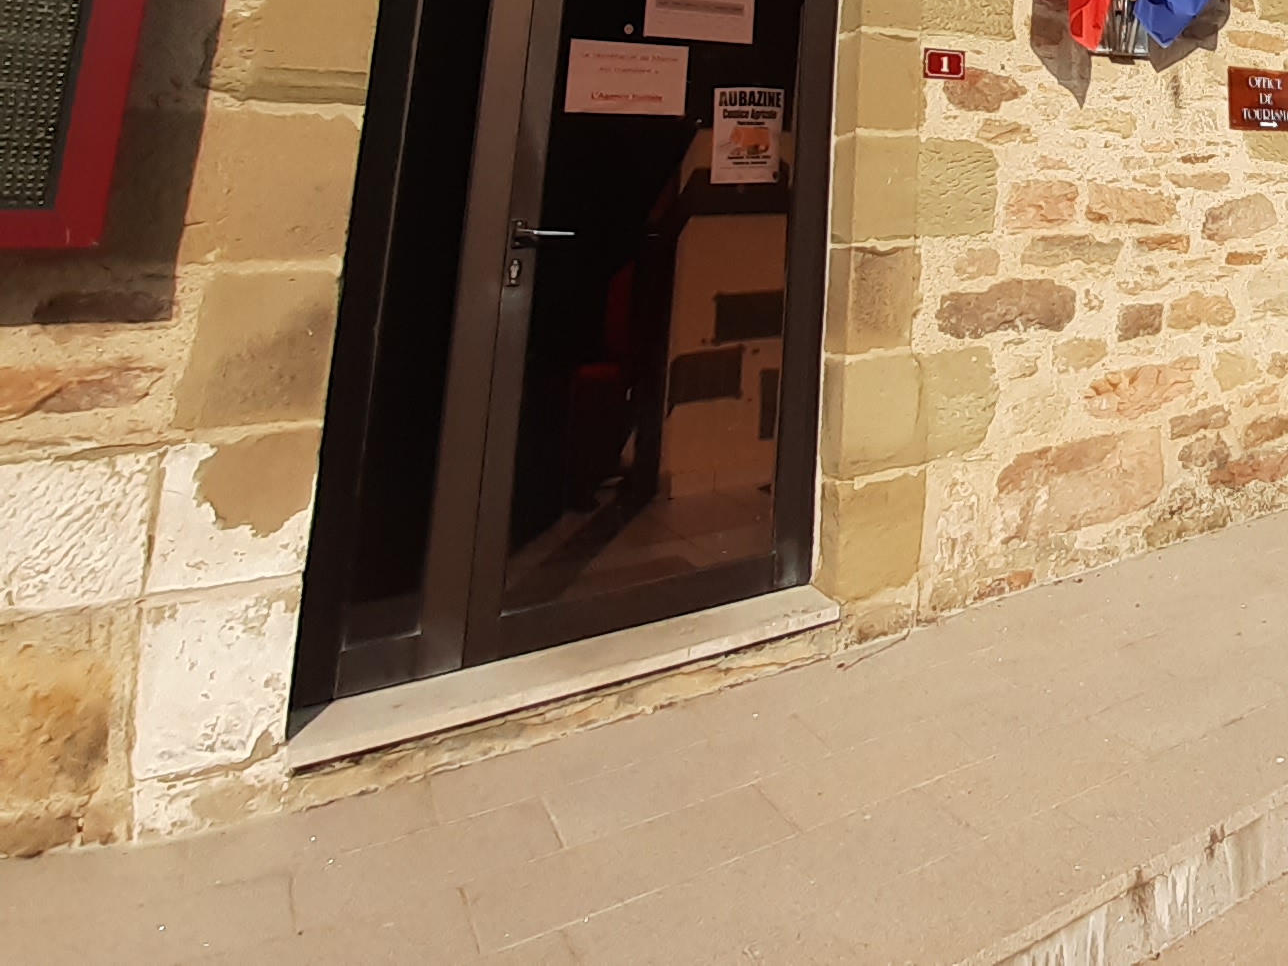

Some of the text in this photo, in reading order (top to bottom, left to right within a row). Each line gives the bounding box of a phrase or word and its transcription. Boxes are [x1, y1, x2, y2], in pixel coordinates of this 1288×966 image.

[940, 55, 950, 73] 1
[1248, 76, 1283, 90] OFFICE
[718, 90, 782, 108] AUBAZINE
[1259, 92, 1273, 105] DE
